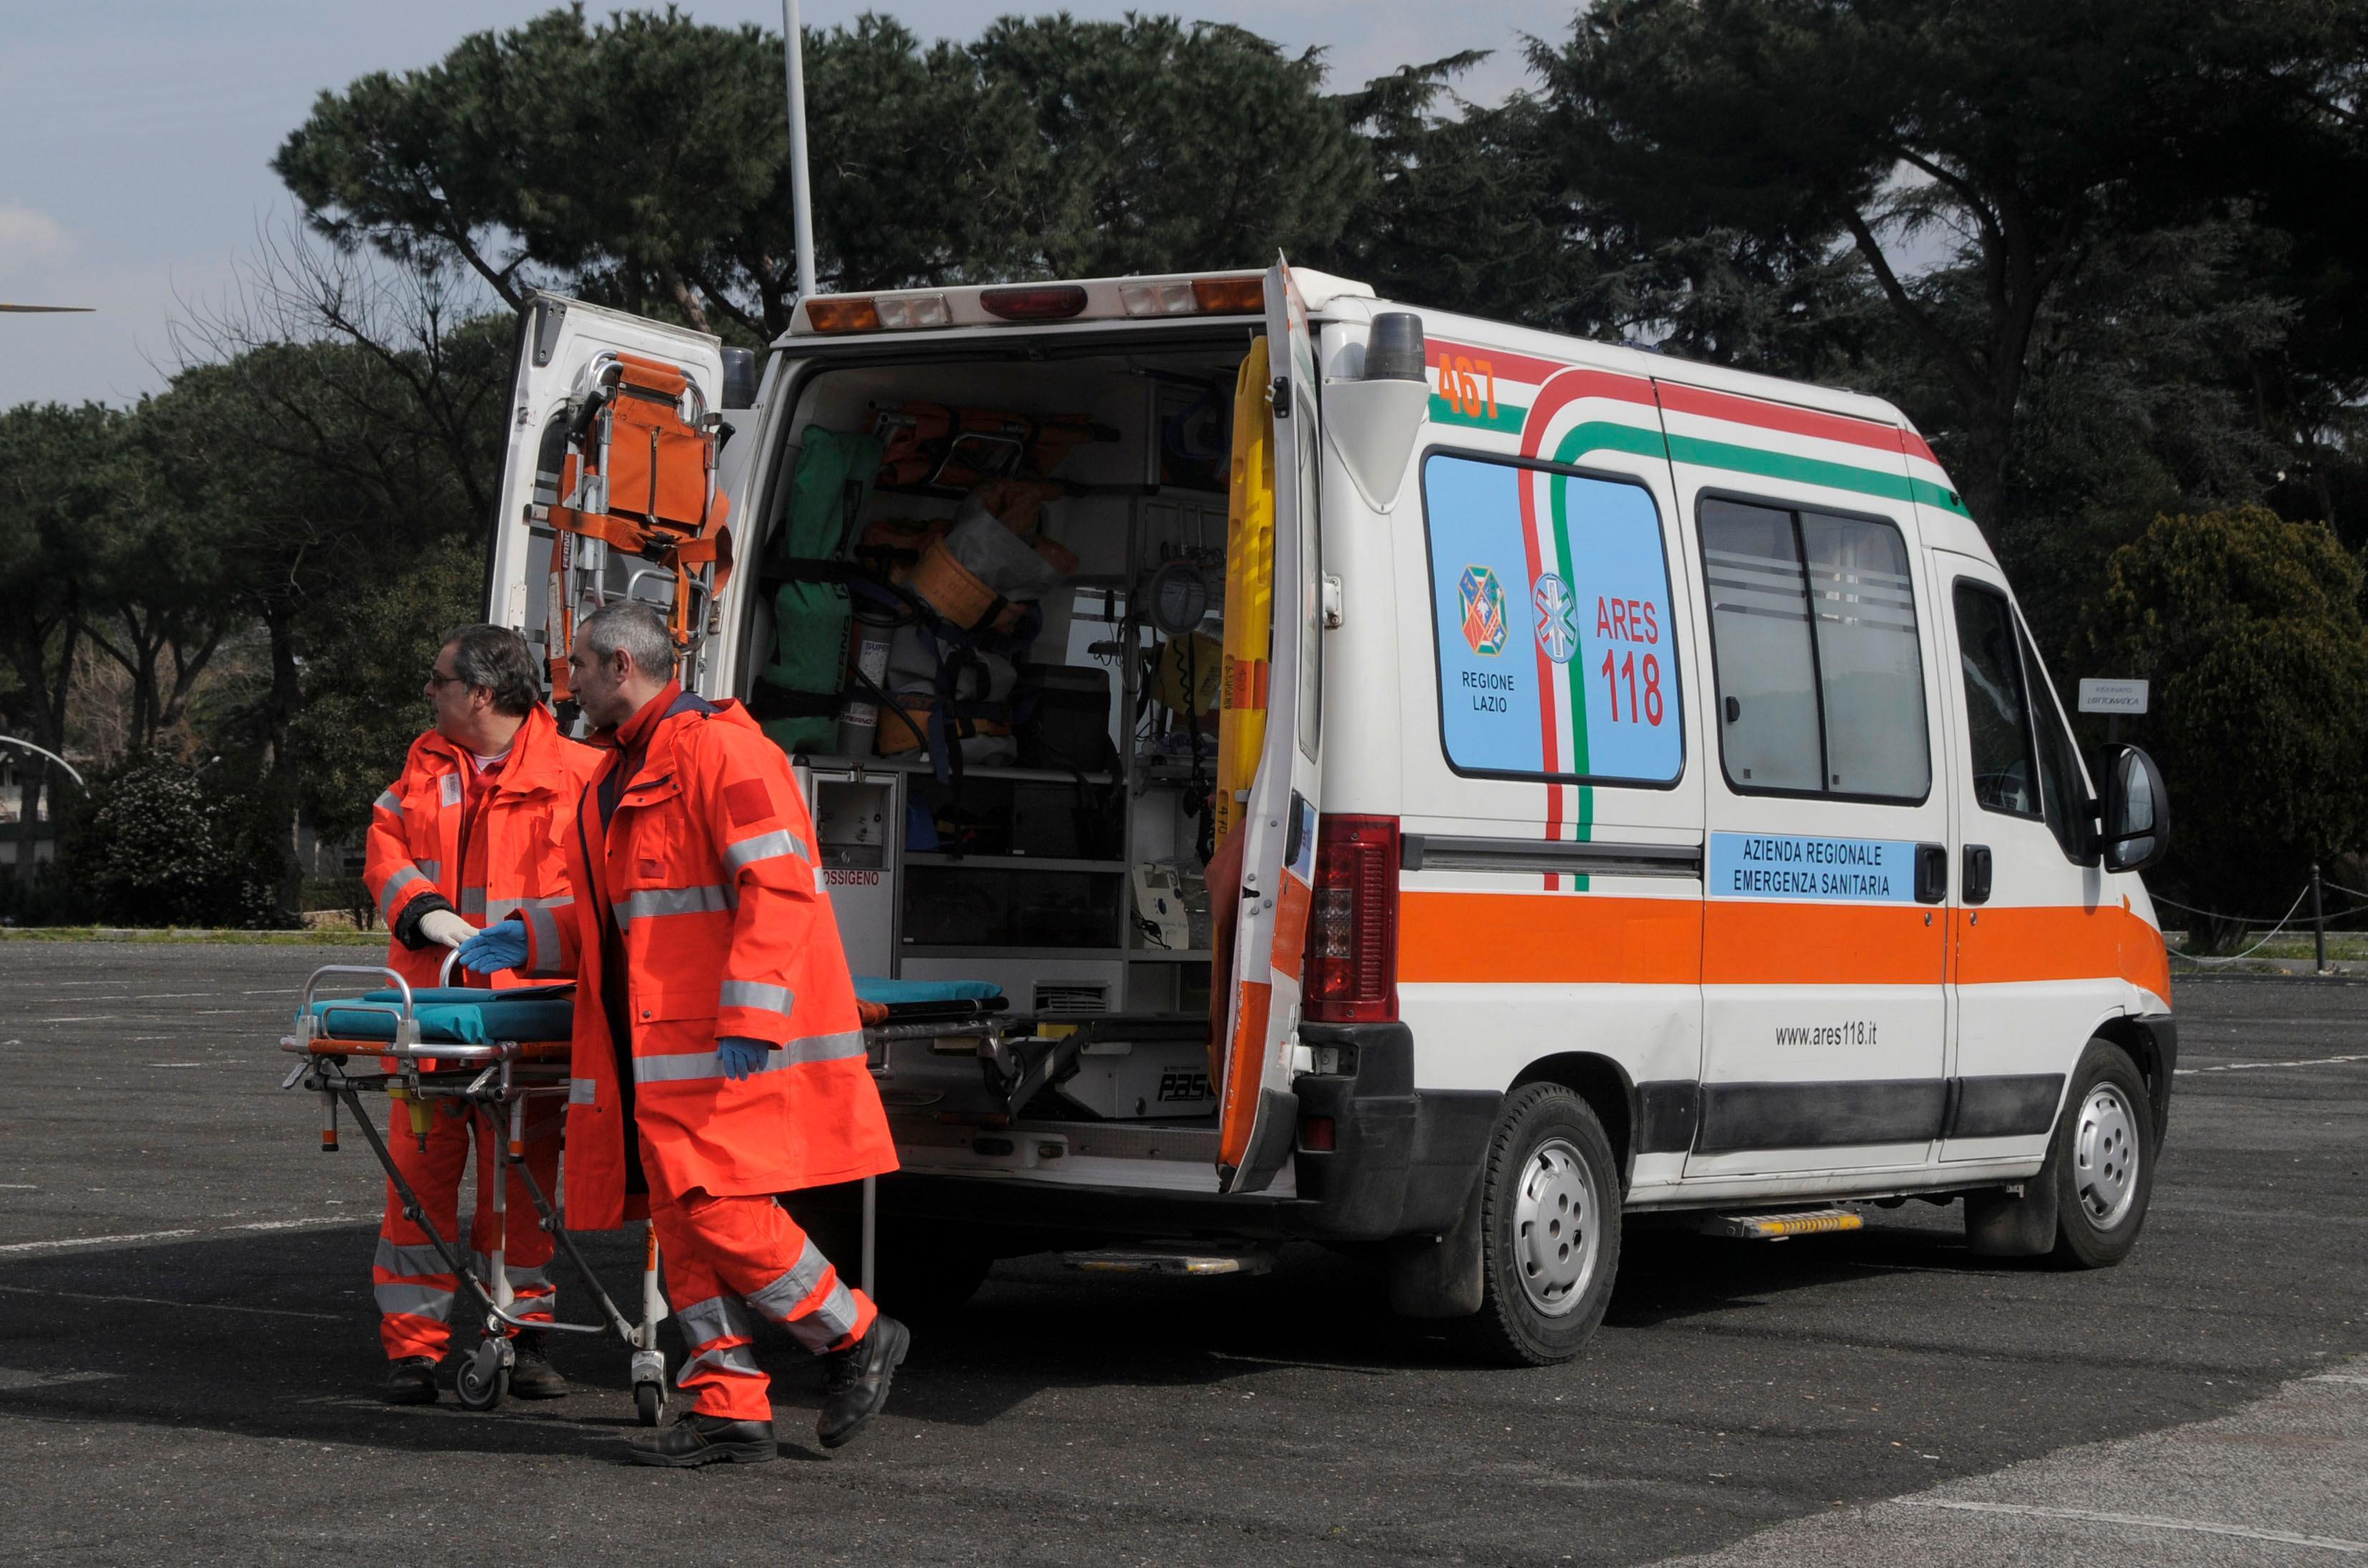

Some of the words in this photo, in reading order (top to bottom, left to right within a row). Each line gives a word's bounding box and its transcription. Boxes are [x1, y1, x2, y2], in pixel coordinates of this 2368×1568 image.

[1439, 353, 1498, 418] 467
[561, 530, 572, 569] FERNO
[1596, 596, 1658, 644] ARES
[1461, 671, 1515, 691] REGIONE
[1601, 649, 1663, 727] 118
[1472, 695, 1507, 713] LAZIO
[845, 715, 873, 725] FERNO
[1743, 838, 1802, 863] AZIENDA
[1807, 842, 1883, 866] REGIONALE
[823, 870, 879, 886] OSSIGENO
[1734, 869, 1817, 894] EMERGENZA
[1821, 872, 1890, 896] SANITARIA
[1775, 1020, 1878, 1045] www.ares118.it
